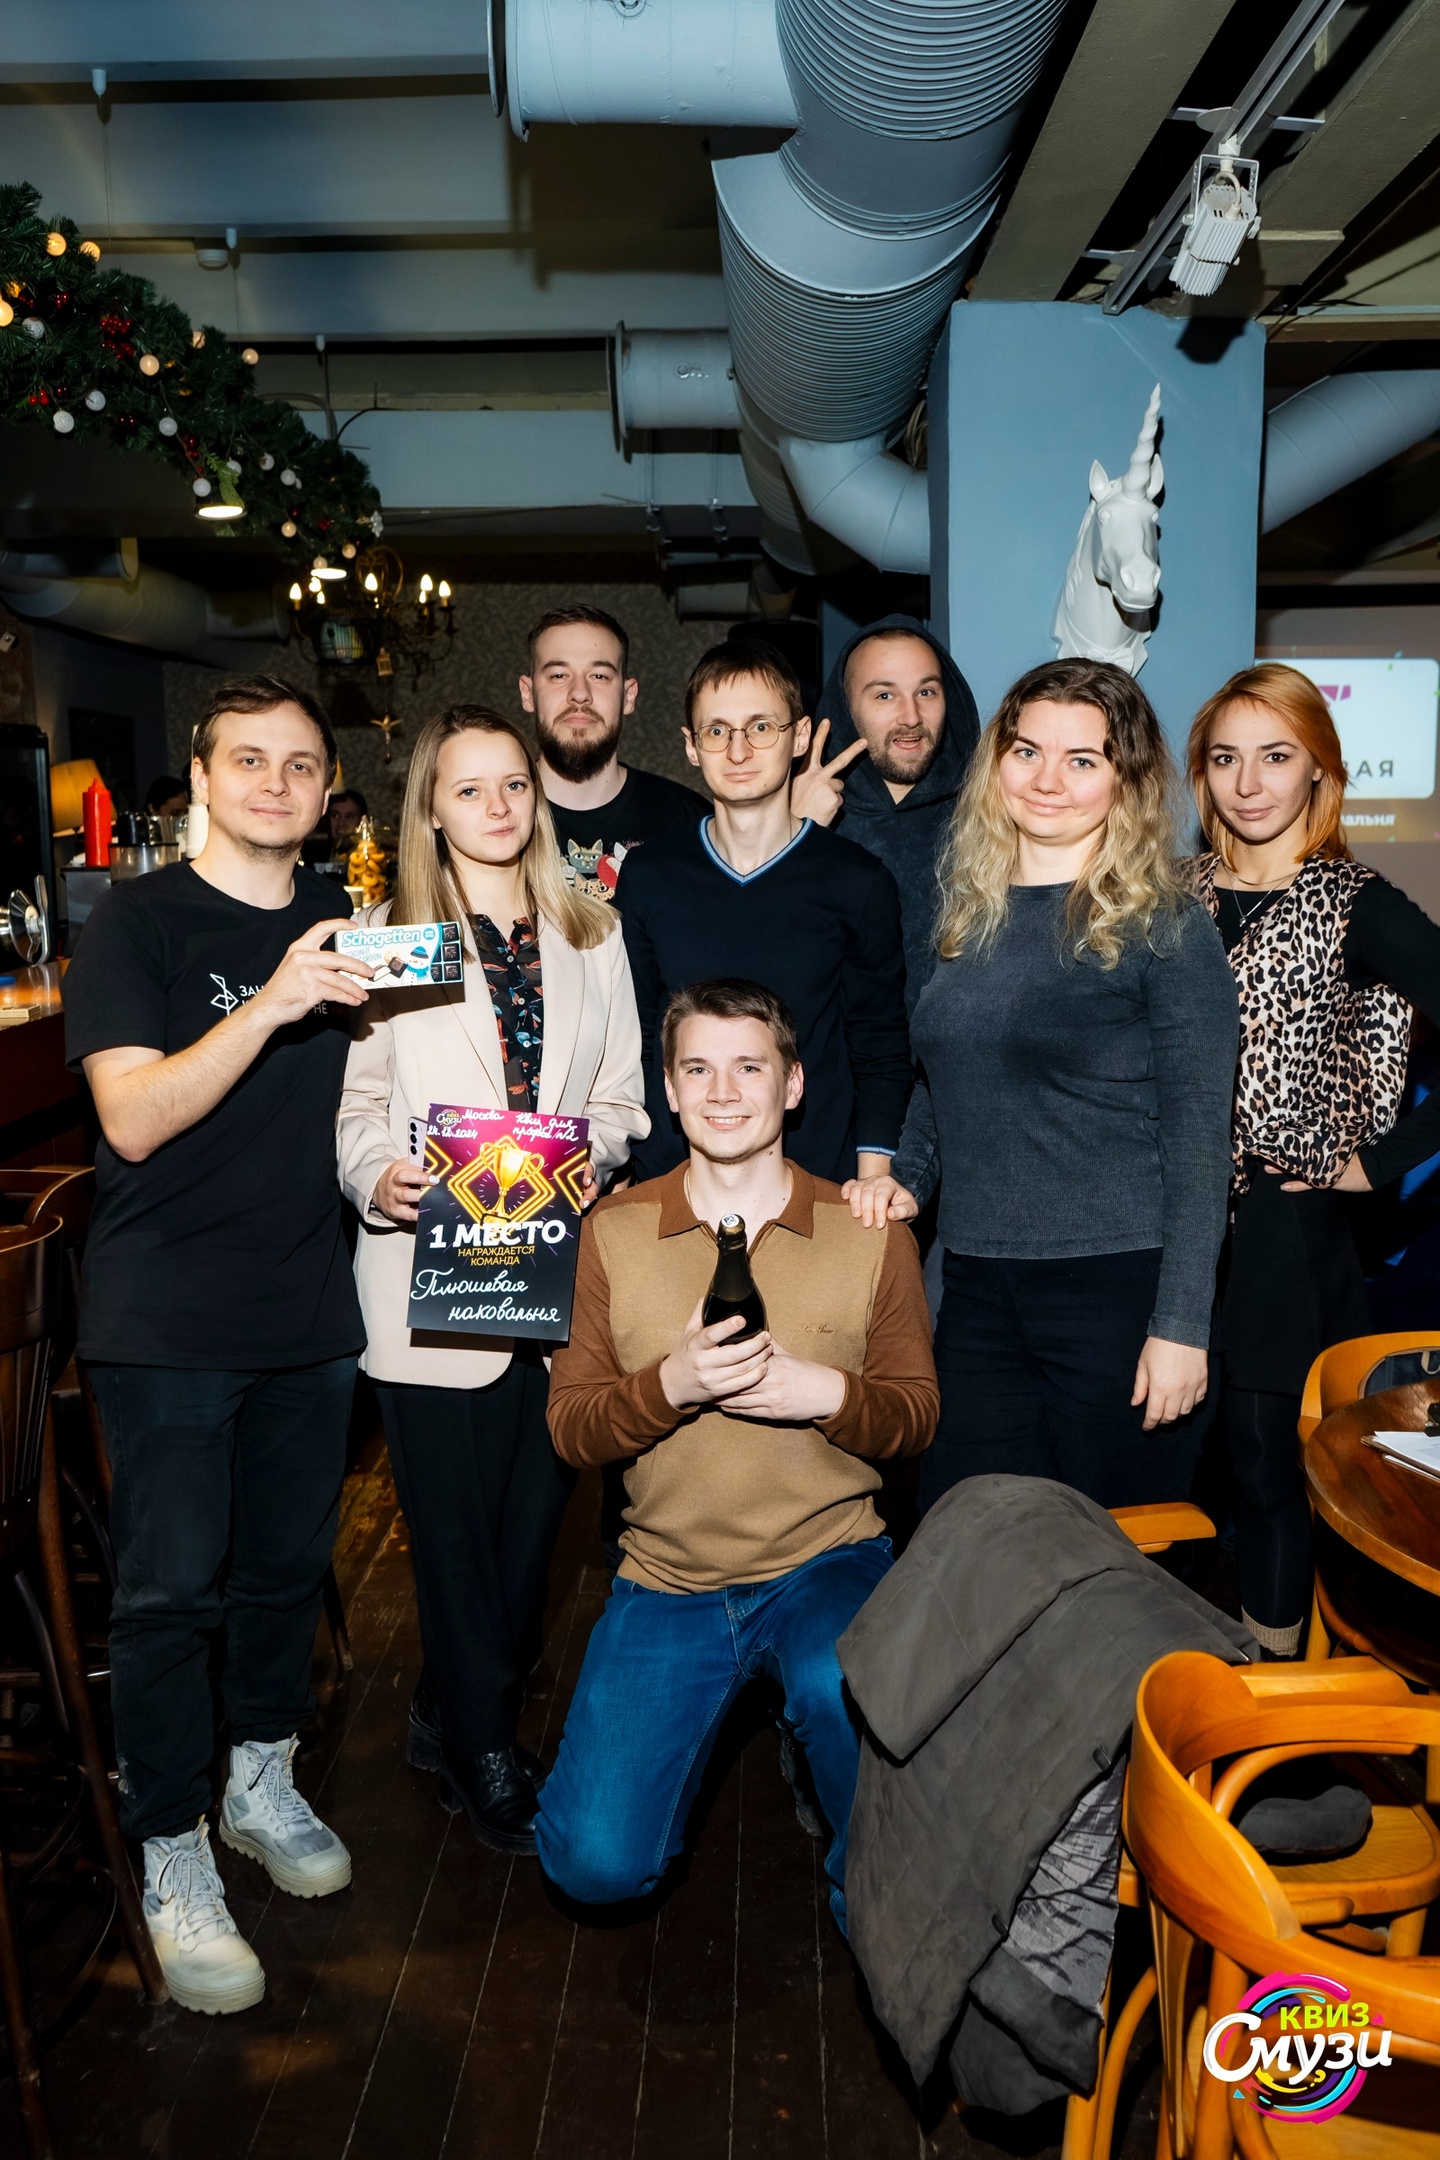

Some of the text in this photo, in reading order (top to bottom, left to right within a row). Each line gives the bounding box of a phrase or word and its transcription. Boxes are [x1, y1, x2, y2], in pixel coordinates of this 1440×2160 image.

[342, 928, 421, 948] Schogetten
[429, 1219, 566, 1249] 1 МЕСТО
[458, 1245, 535, 1257] НАГРАЖДАЕТСЯ
[470, 1256, 520, 1266] КОМАНДА
[410, 1268, 529, 1300] Плюшевая
[448, 1297, 561, 1322] наковальня
